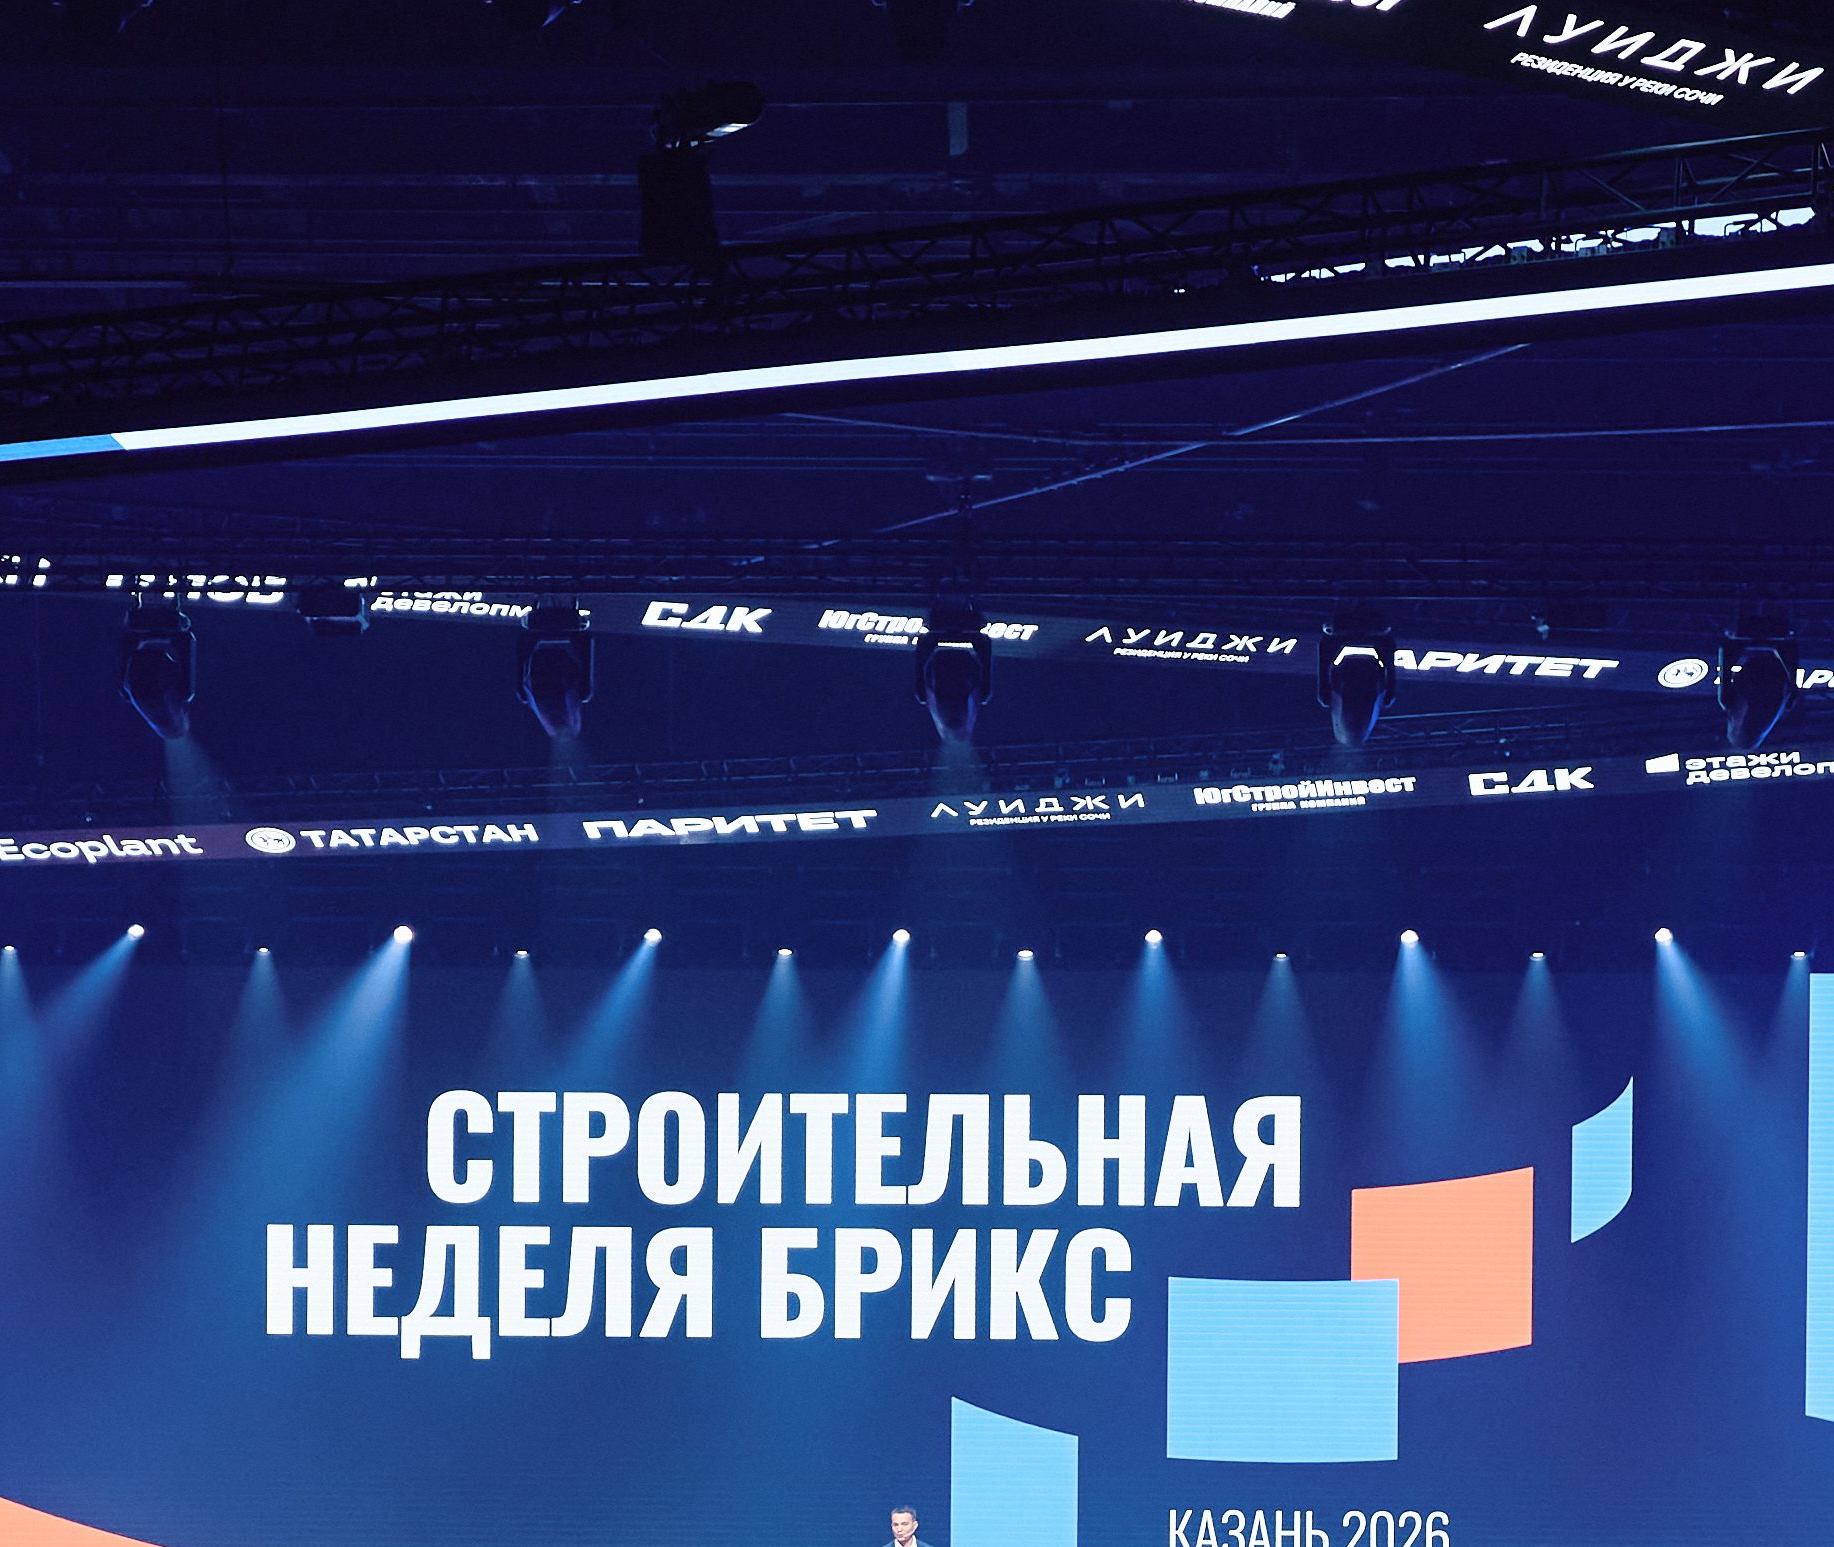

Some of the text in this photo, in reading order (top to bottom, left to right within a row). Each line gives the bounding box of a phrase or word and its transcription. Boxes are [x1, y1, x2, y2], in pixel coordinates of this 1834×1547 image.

[1483, 4, 1825, 95] ЛУИДЖИ
[1510, 51, 1724, 106] РЕЗИДЕНЦИЯ У РЕКИ СОЧИ
[1085, 626, 1298, 654] ЛУИДЖИ
[1113, 647, 1182, 660] РЕЗИДЕНЦИЯ
[1190, 652, 1218, 661] РЕКИ
[1218, 653, 1250, 663] СОЧИ
[1685, 751, 1801, 770] этажи
[1193, 776, 1417, 805] ЮгСтройИнвест
[931, 793, 1145, 818] ЛУИДЖИ
[969, 816, 1039, 826] РЕЗИДЕНЦИЯ
[1050, 814, 1078, 823] РЕКИ
[1078, 812, 1111, 821] СОЧИ
[299, 823, 540, 848] ТАТАРСТАН
[582, 809, 878, 839] ПАРИТЕТ
[426, 1089, 1303, 1208] СТРОИТЕЛЬНАЯ
[265, 1223, 1133, 1360] НЕДЕЛЯ БРИКС
